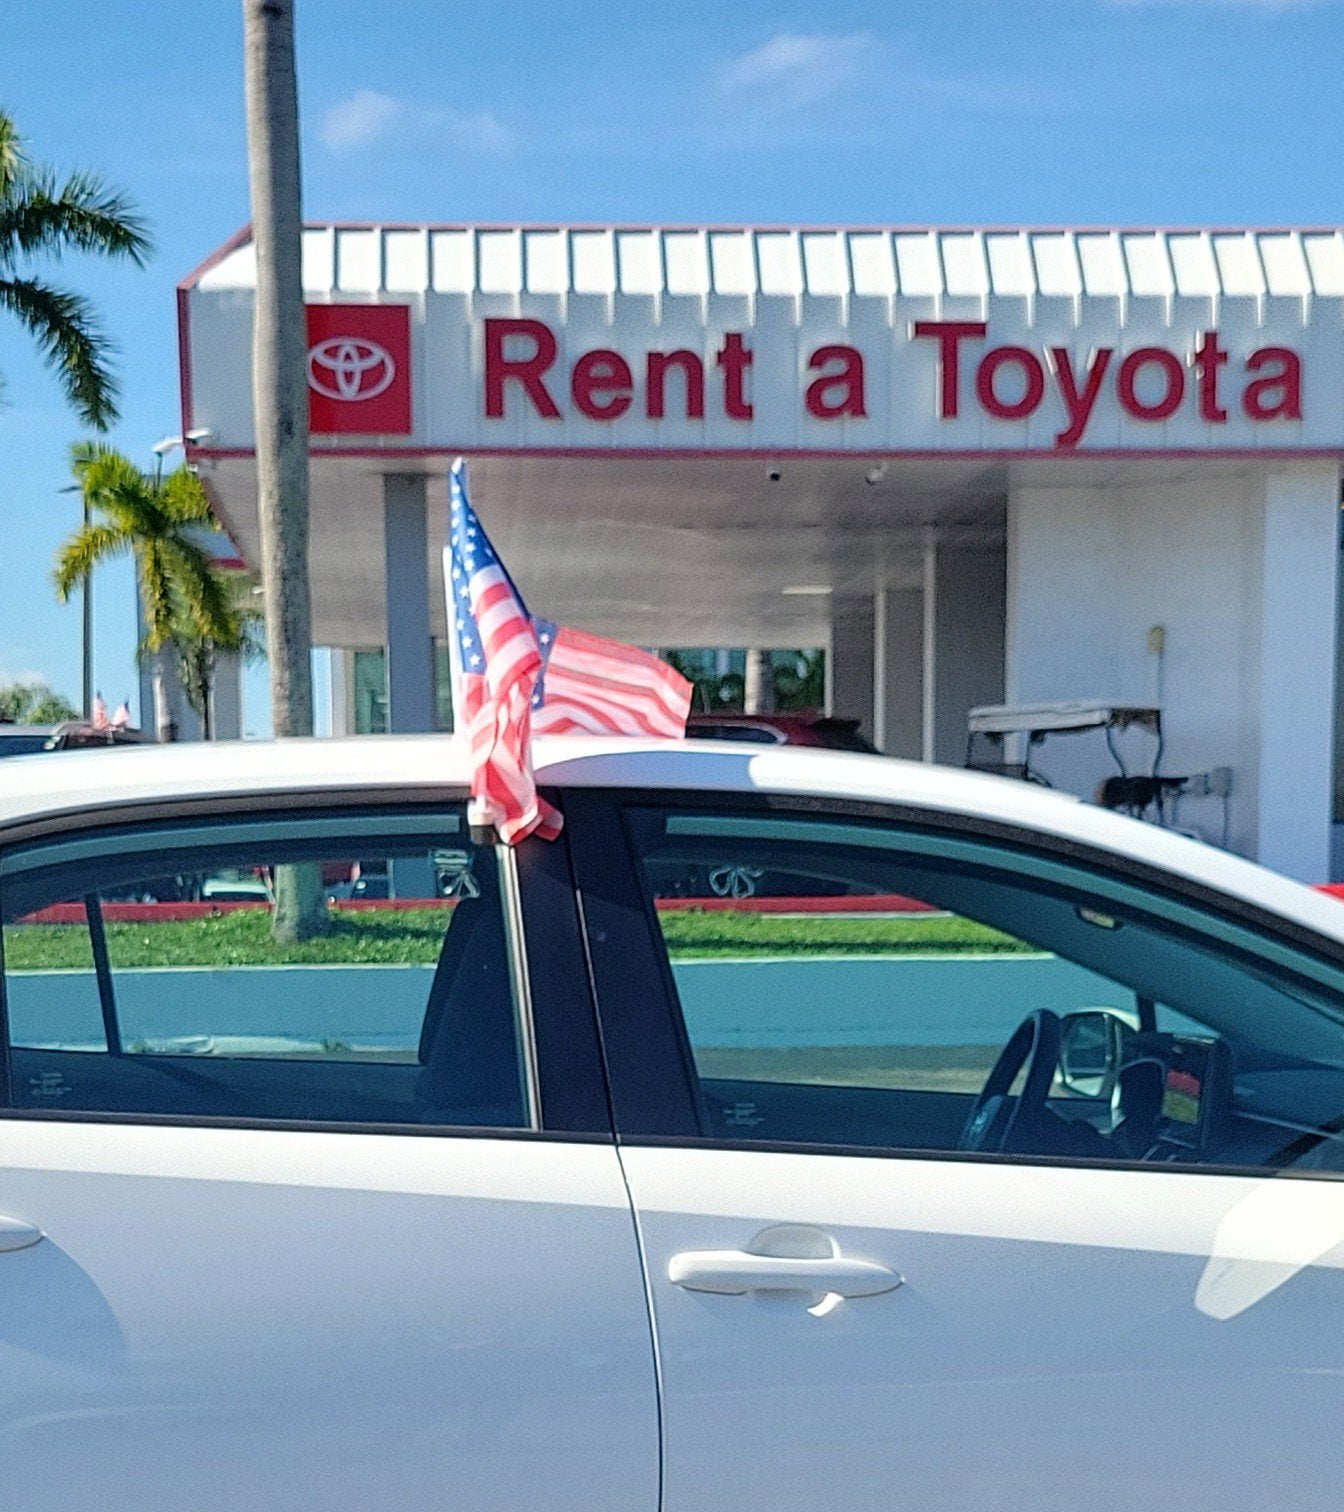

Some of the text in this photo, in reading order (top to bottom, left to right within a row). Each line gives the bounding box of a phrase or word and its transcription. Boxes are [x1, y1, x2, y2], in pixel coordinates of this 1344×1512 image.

[484, 318, 1303, 447] Rent a Toyota
